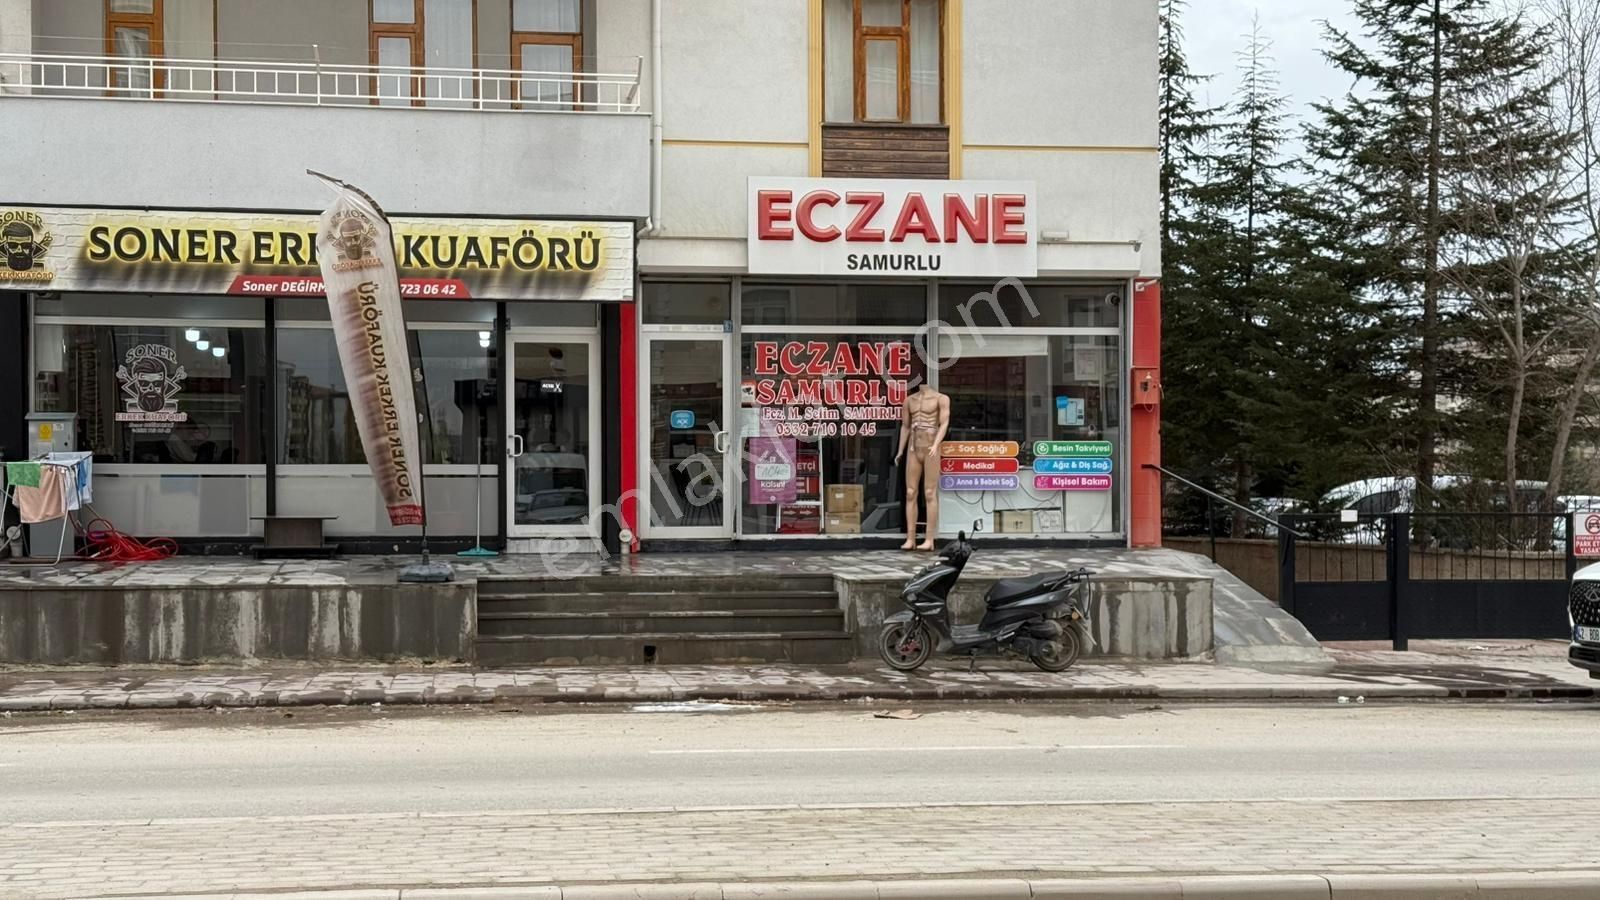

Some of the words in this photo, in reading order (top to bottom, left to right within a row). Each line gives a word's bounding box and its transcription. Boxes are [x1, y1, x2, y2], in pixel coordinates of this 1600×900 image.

[757, 189, 1028, 244] ECZANE
[89, 226, 240, 264] SONER
[402, 229, 600, 271] KUAFÖRÜ
[847, 253, 941, 270] SAMURLU
[242, 280, 278, 292] Soner
[400, 284, 421, 294] 723
[423, 284, 439, 295] 06
[441, 284, 456, 295] 42
[125, 344, 178, 364] SONER
[755, 341, 911, 375] ECZANE
[755, 379, 908, 405] SAMURLU
[762, 407, 785, 420] Ecz.
[788, 407, 802, 420] M.
[776, 423, 808, 436] 0332
[812, 423, 837, 436] 710
[841, 423, 857, 436] 10
[859, 423, 877, 436] 45
[958, 444, 975, 454] Saç
[977, 444, 1008, 454] Sağlığı
[1052, 444, 1074, 452] Besin
[1075, 444, 1110, 453] Takviyesi
[796, 461, 816, 471] ETÇİ
[963, 462, 995, 470] Medikal
[1052, 461, 1070, 470] Ağız
[1071, 461, 1077, 469] &
[1078, 461, 1090, 470] Diş
[956, 478, 973, 486] Anne
[974, 478, 979, 486] &
[980, 478, 1000, 486] Bebek
[1052, 477, 1079, 487] Kişisel
[1081, 477, 1108, 486] Bakım
